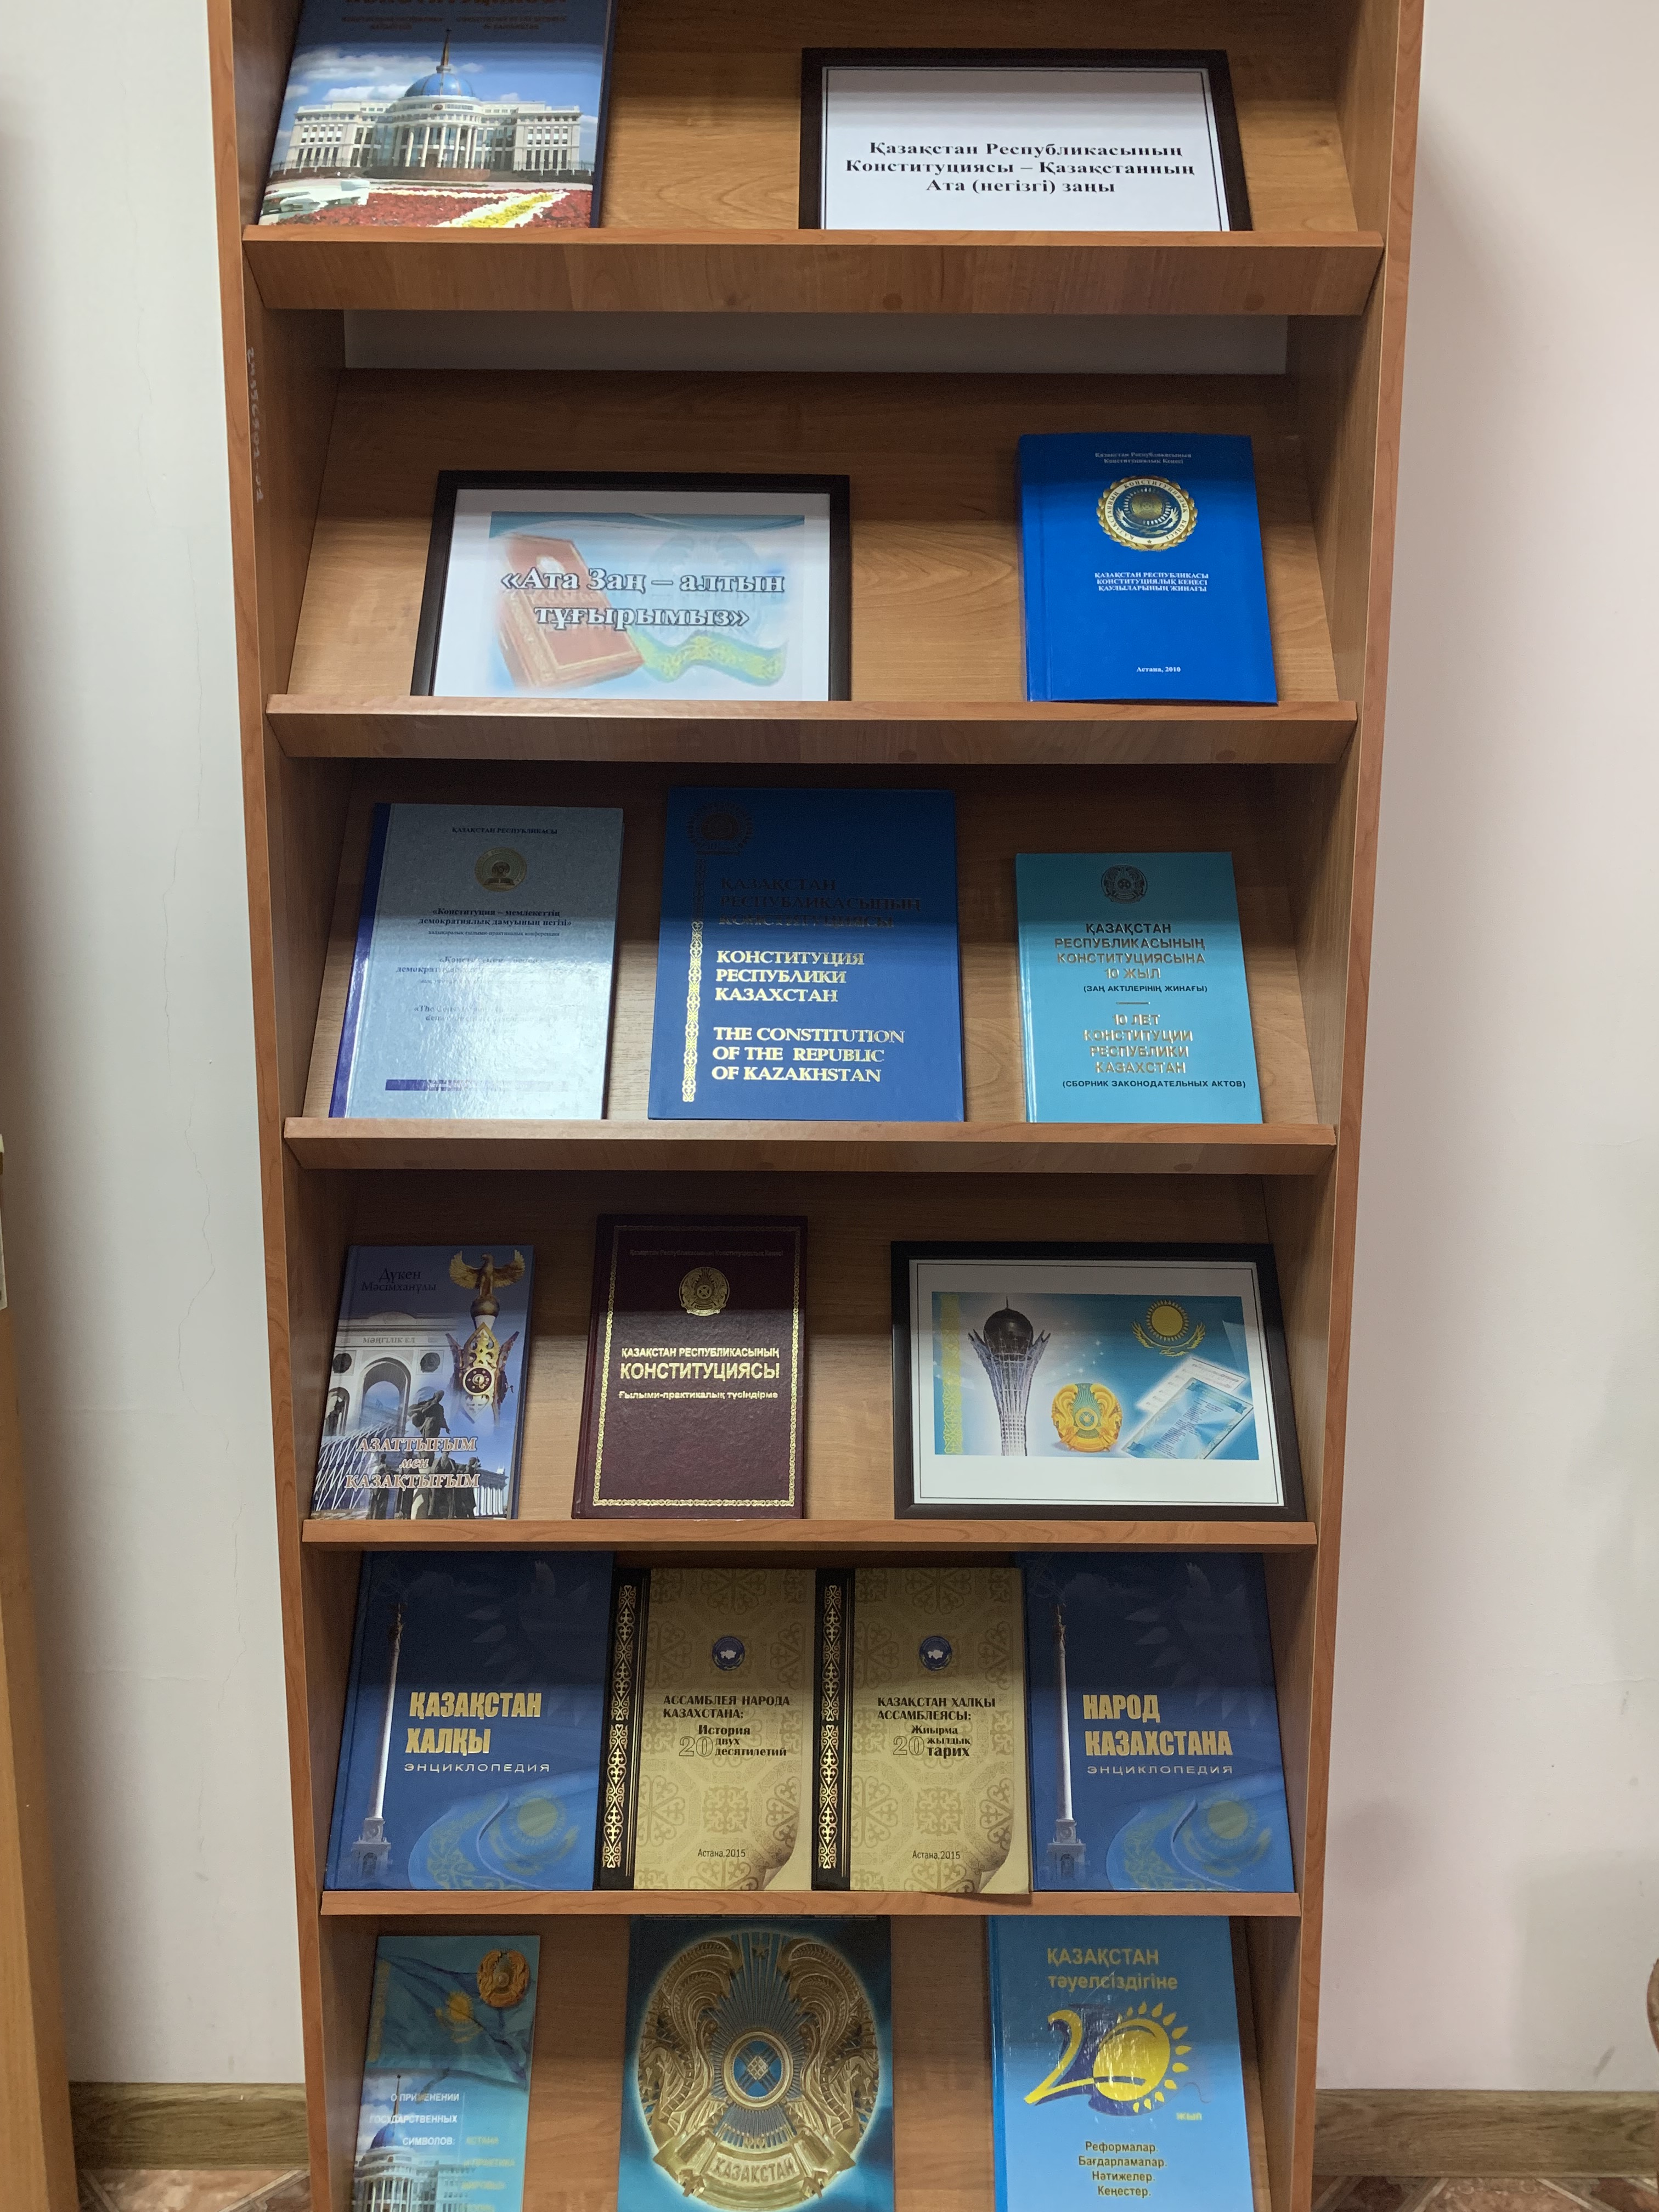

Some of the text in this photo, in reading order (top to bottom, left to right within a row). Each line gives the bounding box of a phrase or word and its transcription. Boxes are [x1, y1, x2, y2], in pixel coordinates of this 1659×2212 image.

[870, 142, 1183, 158] Қазақстан Республикасының
[845, 159, 1014, 176] Конституциясы
[1039, 161, 1195, 176] Қазақстанның
[926, 179, 1115, 195] Ата (негізгі) заңы
[500, 567, 579, 591] «Ата
[588, 568, 646, 594] Заң
[679, 574, 785, 593] алтын
[534, 606, 750, 631] тұғырымыз»
[720, 879, 836, 893] ҚАЗАҚСТАН
[719, 895, 921, 912] РЕСПУБЛИКАСЫНЫҢ
[432, 908, 495, 917] «Конституция
[418, 918, 490, 926] демократиялық
[1086, 923, 1171, 935] ҚАЗАҚСТАН
[1055, 938, 1206, 950] РЕСПУБЛИКАСЫНЫҢ
[716, 950, 865, 967] КОНСТИТУЦИЯ
[1057, 953, 1205, 966] КОНСТИТУЦИЯСЫНА
[715, 969, 847, 984] РЕСПУБЛИКИ
[1105, 968, 1161, 979] 10 ЖЫЛ
[715, 988, 838, 1002] КАЗАХСТАН
[1112, 1014, 1160, 1025] 10 ЛЕТ
[713, 1027, 905, 1044] THE CONSTITUTION
[1083, 1030, 1193, 1043] КОНСТИТУЦИИ
[713, 1047, 884, 1062] OF THE REPUBLIC
[1090, 1046, 1189, 1057] РЕСПУБЛИКИ
[712, 1066, 881, 1082] OF KAZAKHSTAN
[1095, 1062, 1186, 1074] КАЗАХСТАН
[1111, 1080, 1209, 1088] ЗАКОНОДАТЕЛЬНЫХ
[379, 1268, 421, 1284] Дүкен
[622, 1348, 780, 1358] ҚАЗАҚСТАН РЕСПУБЛИКАСЫНЫҢ
[620, 1363, 780, 1381] КОНСТИТУЦИЯСЫ
[618, 1391, 778, 1400] Ғылыми-практикалық түсіндірме
[356, 1436, 478, 1452] АЗАТТЫҒЫМ
[399, 1457, 430, 1469] мен
[345, 1474, 481, 1491] ҚАЗАҚТЫҒЫМ
[409, 1691, 543, 1719] ҚАЗАҚСТАН
[663, 1695, 791, 1706] АССАМБЛЕЯ НАРОДА
[878, 1697, 995, 1708] ҚАЗАҚСТАН ХАЛҚЫ
[663, 1708, 744, 1718] КАЗАХСТАНА:
[878, 1710, 972, 1720] АССАМБЛЕЯСЫ:
[1082, 1694, 1161, 1723] НАРОД
[698, 1724, 751, 1737] История
[911, 1725, 958, 1736] Жиырма
[405, 1728, 491, 1756] ХАЛҚЫ
[679, 1736, 741, 1757] 20 двух
[893, 1736, 925, 1756] 20
[1085, 1730, 1234, 1756] КАЗАХСТАНА
[715, 1747, 787, 1756] десятилетий
[926, 1747, 970, 1759] тарих
[404, 1763, 550, 1773] ЭНЦИКЛОПЕДИЯ
[1087, 1764, 1233, 1775] ЭНЦИКЛОПЕДИЯ
[1047, 1948, 1159, 1967] ҚАЗАҚСТАН
[1048, 1973, 1178, 1992] тәуелсіздігіне
[391, 2093, 398, 2102] О
[369, 2114, 458, 2124] ГОСУДАРСТВЕННЫХ
[402, 2136, 455, 2146] СИМВОЛОВ:
[1085, 2141, 1159, 2155] Реформалар.
[1079, 2155, 1167, 2168] Бағдарламалар.
[1092, 2171, 1155, 2183] Нәтижелер.
[1097, 2186, 1152, 2198] Кеңестер.
